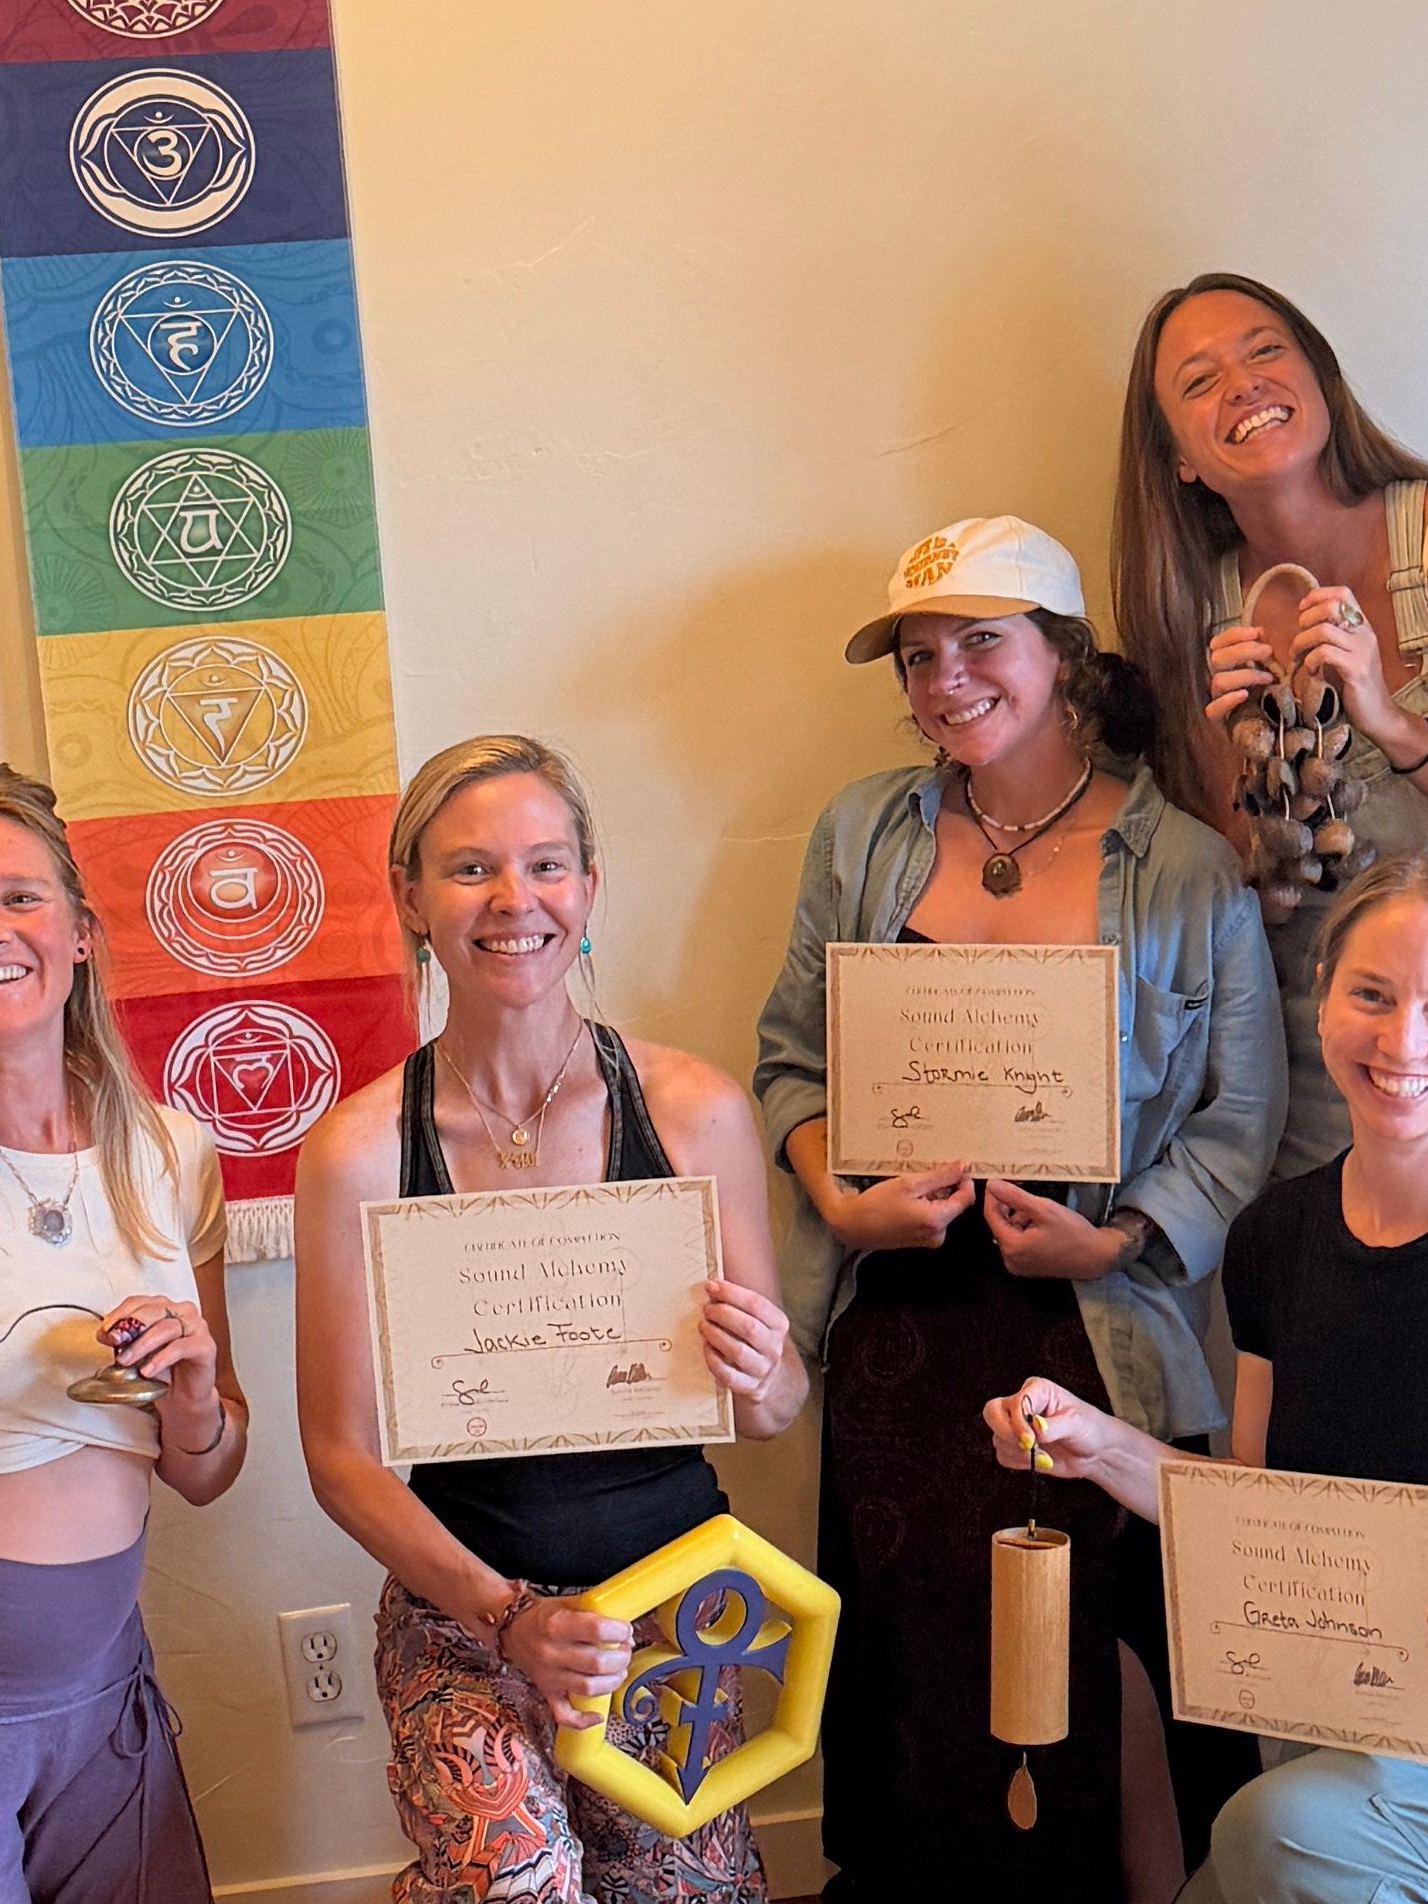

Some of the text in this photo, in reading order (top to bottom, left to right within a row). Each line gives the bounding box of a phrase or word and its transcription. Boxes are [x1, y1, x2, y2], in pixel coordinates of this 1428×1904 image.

[899, 1008, 1039, 1028] Sound Alchemy
[909, 1039, 1033, 1056] Certification
[459, 1258, 628, 1284] Sound Alchemy
[473, 1293, 622, 1317] Certification
[464, 1328, 546, 1354] Jackie
[1231, 1540, 1371, 1576] Sound Alchemy
[1243, 1574, 1365, 1607] Certification
[1306, 1612, 1383, 1639] Johnson
